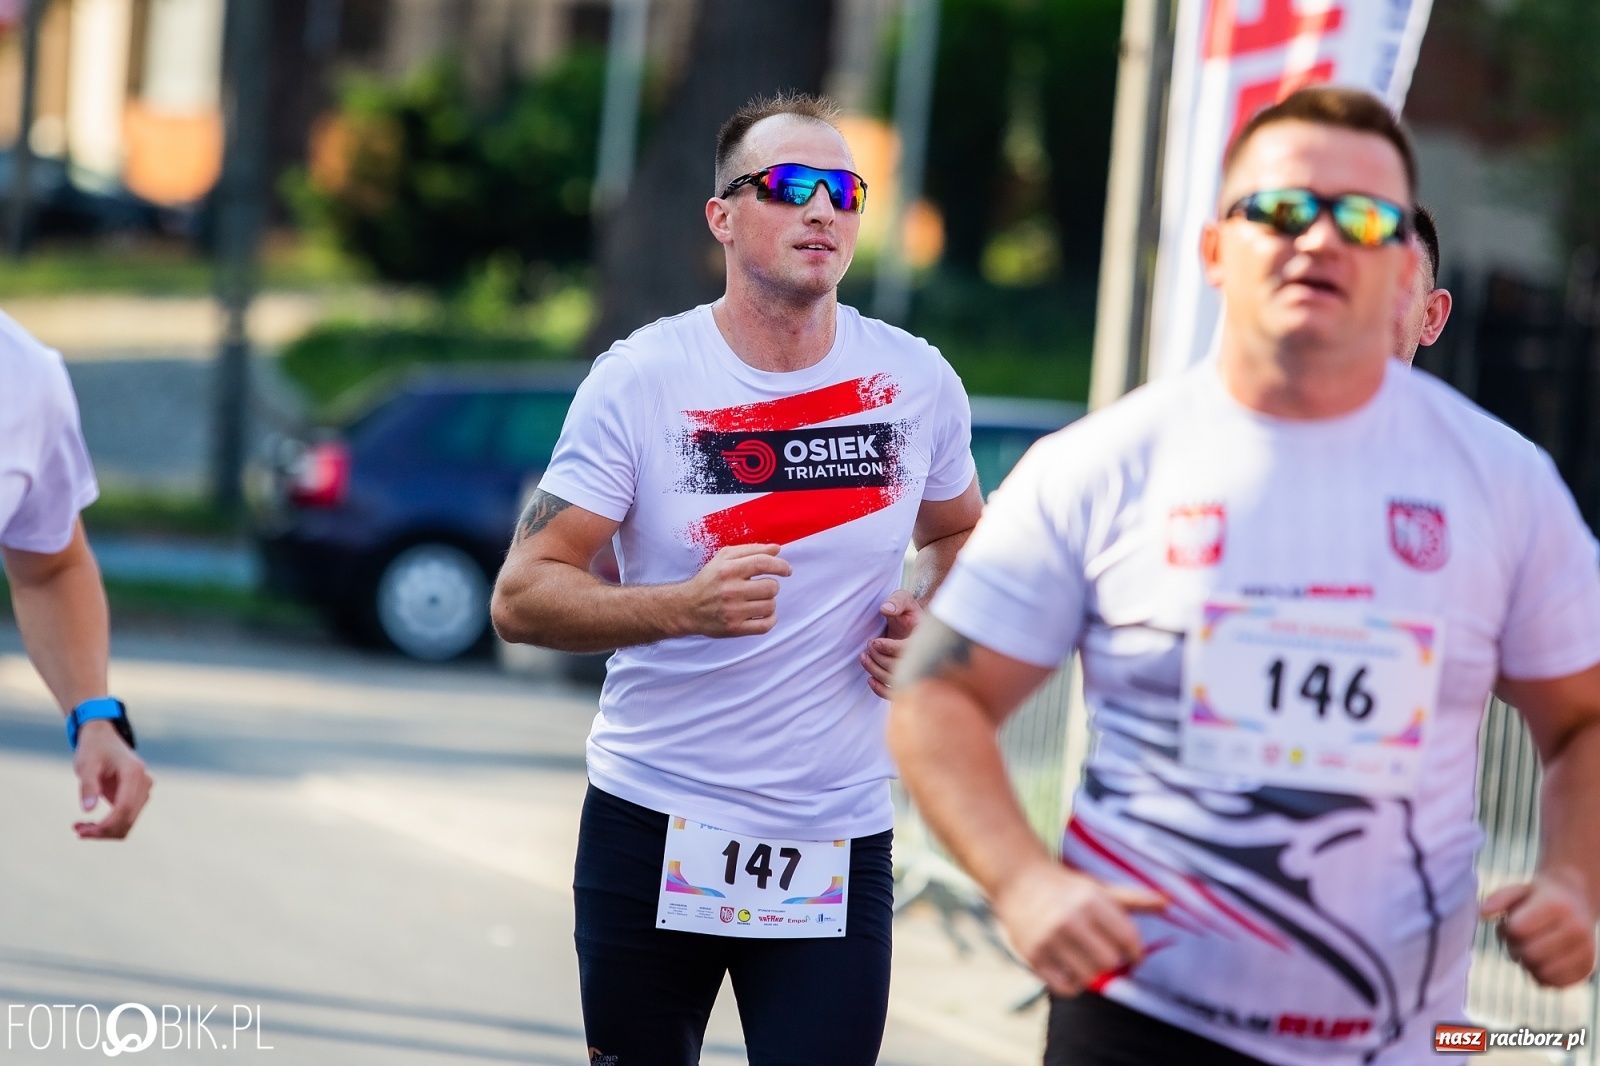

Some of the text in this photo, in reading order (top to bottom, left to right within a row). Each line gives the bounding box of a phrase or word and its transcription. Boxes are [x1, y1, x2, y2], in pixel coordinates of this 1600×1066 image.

[784, 434, 879, 463] OSIEK
[784, 461, 883, 480] TRIATHLON
[1267, 657, 1375, 722] 146
[721, 839, 802, 891] 147
